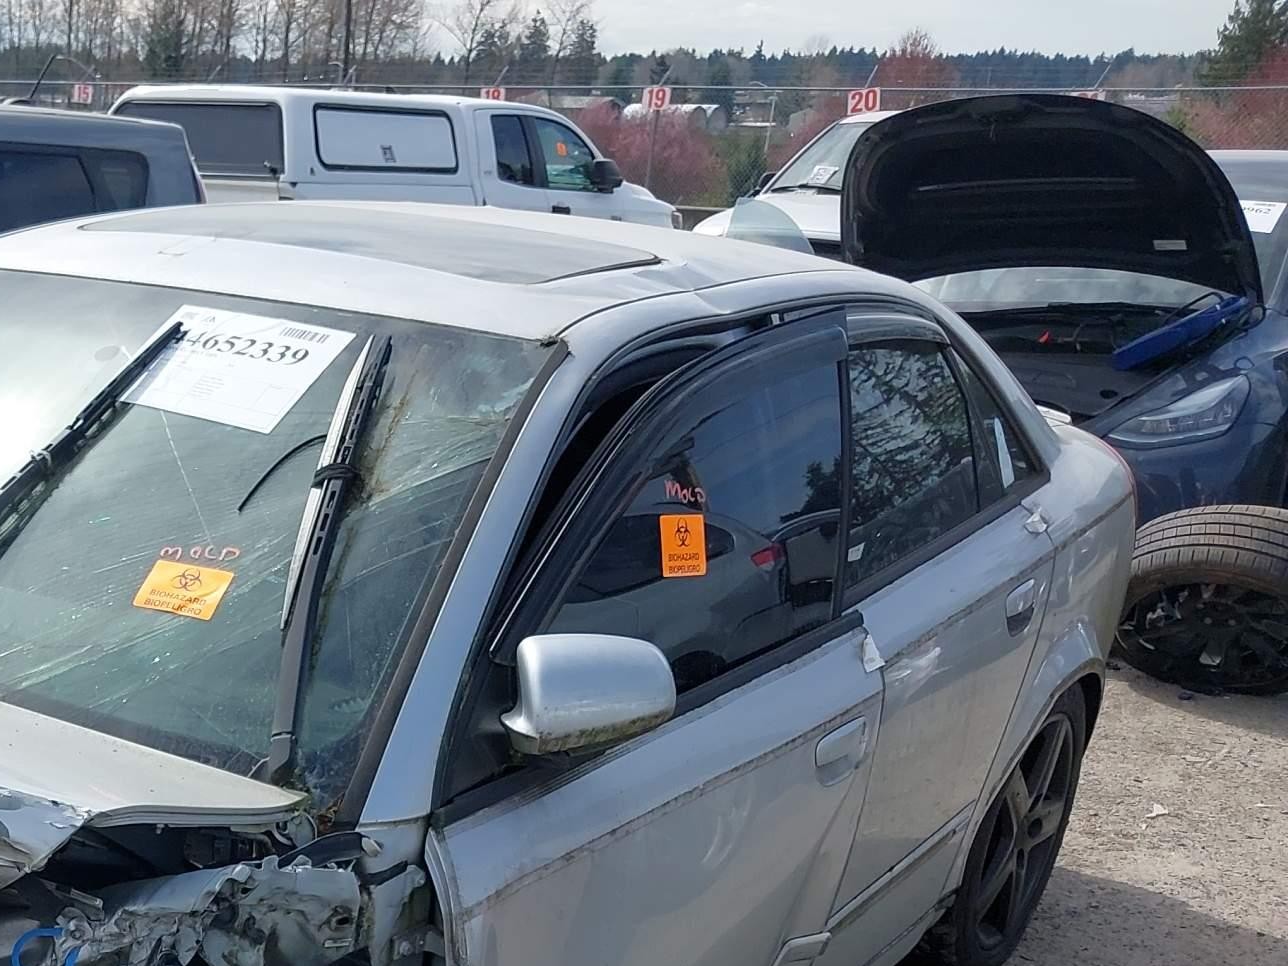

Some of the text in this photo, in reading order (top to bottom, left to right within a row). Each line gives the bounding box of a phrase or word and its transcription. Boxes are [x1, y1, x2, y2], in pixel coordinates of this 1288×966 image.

[77, 84, 90, 103] 15
[647, 88, 666, 109] 19
[850, 90, 878, 113] 20
[172, 328, 310, 366] 44652339
[668, 552, 700, 562] BIOHAZARD
[143, 598, 202, 616] BIOPELIGRO
[149, 589, 207, 606] BIOHAZARD
